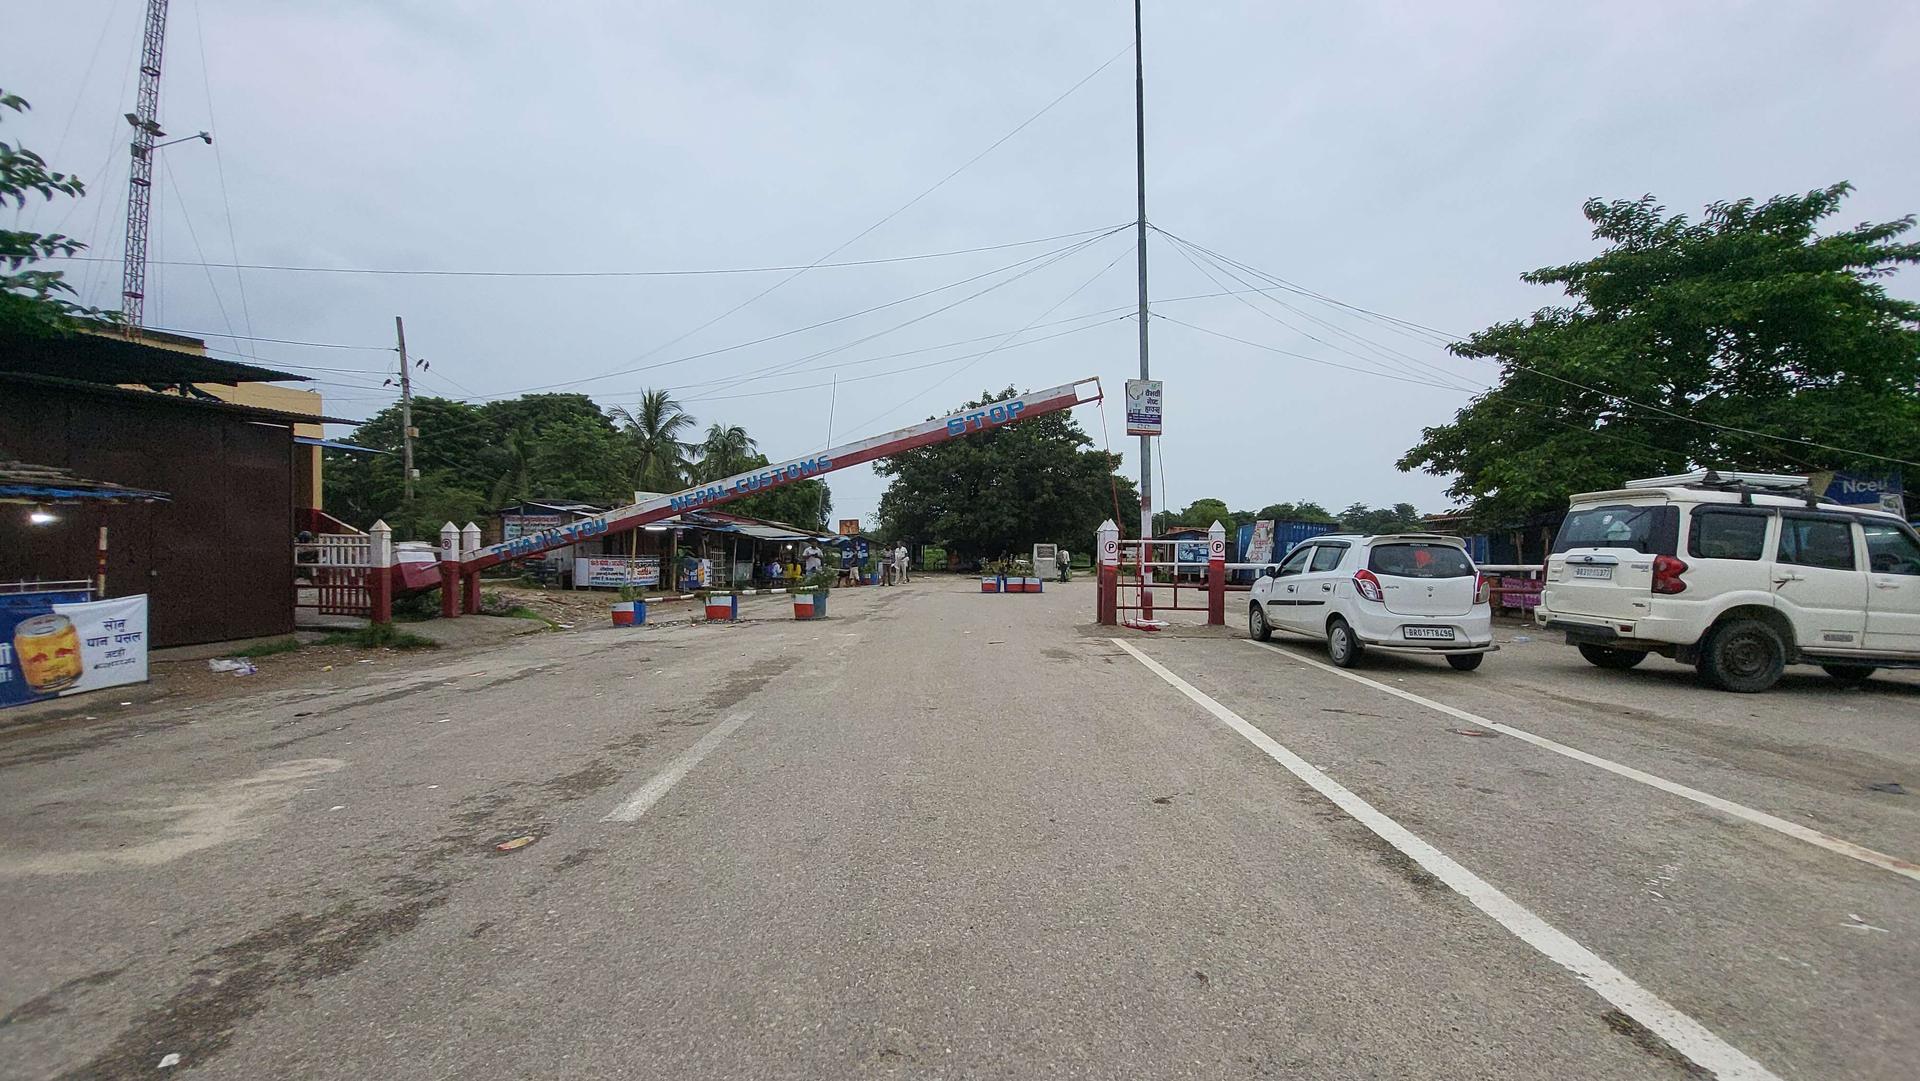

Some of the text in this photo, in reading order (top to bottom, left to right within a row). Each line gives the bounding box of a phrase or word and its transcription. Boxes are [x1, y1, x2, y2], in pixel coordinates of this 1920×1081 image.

[947, 401, 1024, 436] STOP
[670, 455, 832, 511] NEPAL CUSTOMS
[491, 529, 566, 560] THANK
[566, 518, 608, 539] YOU
